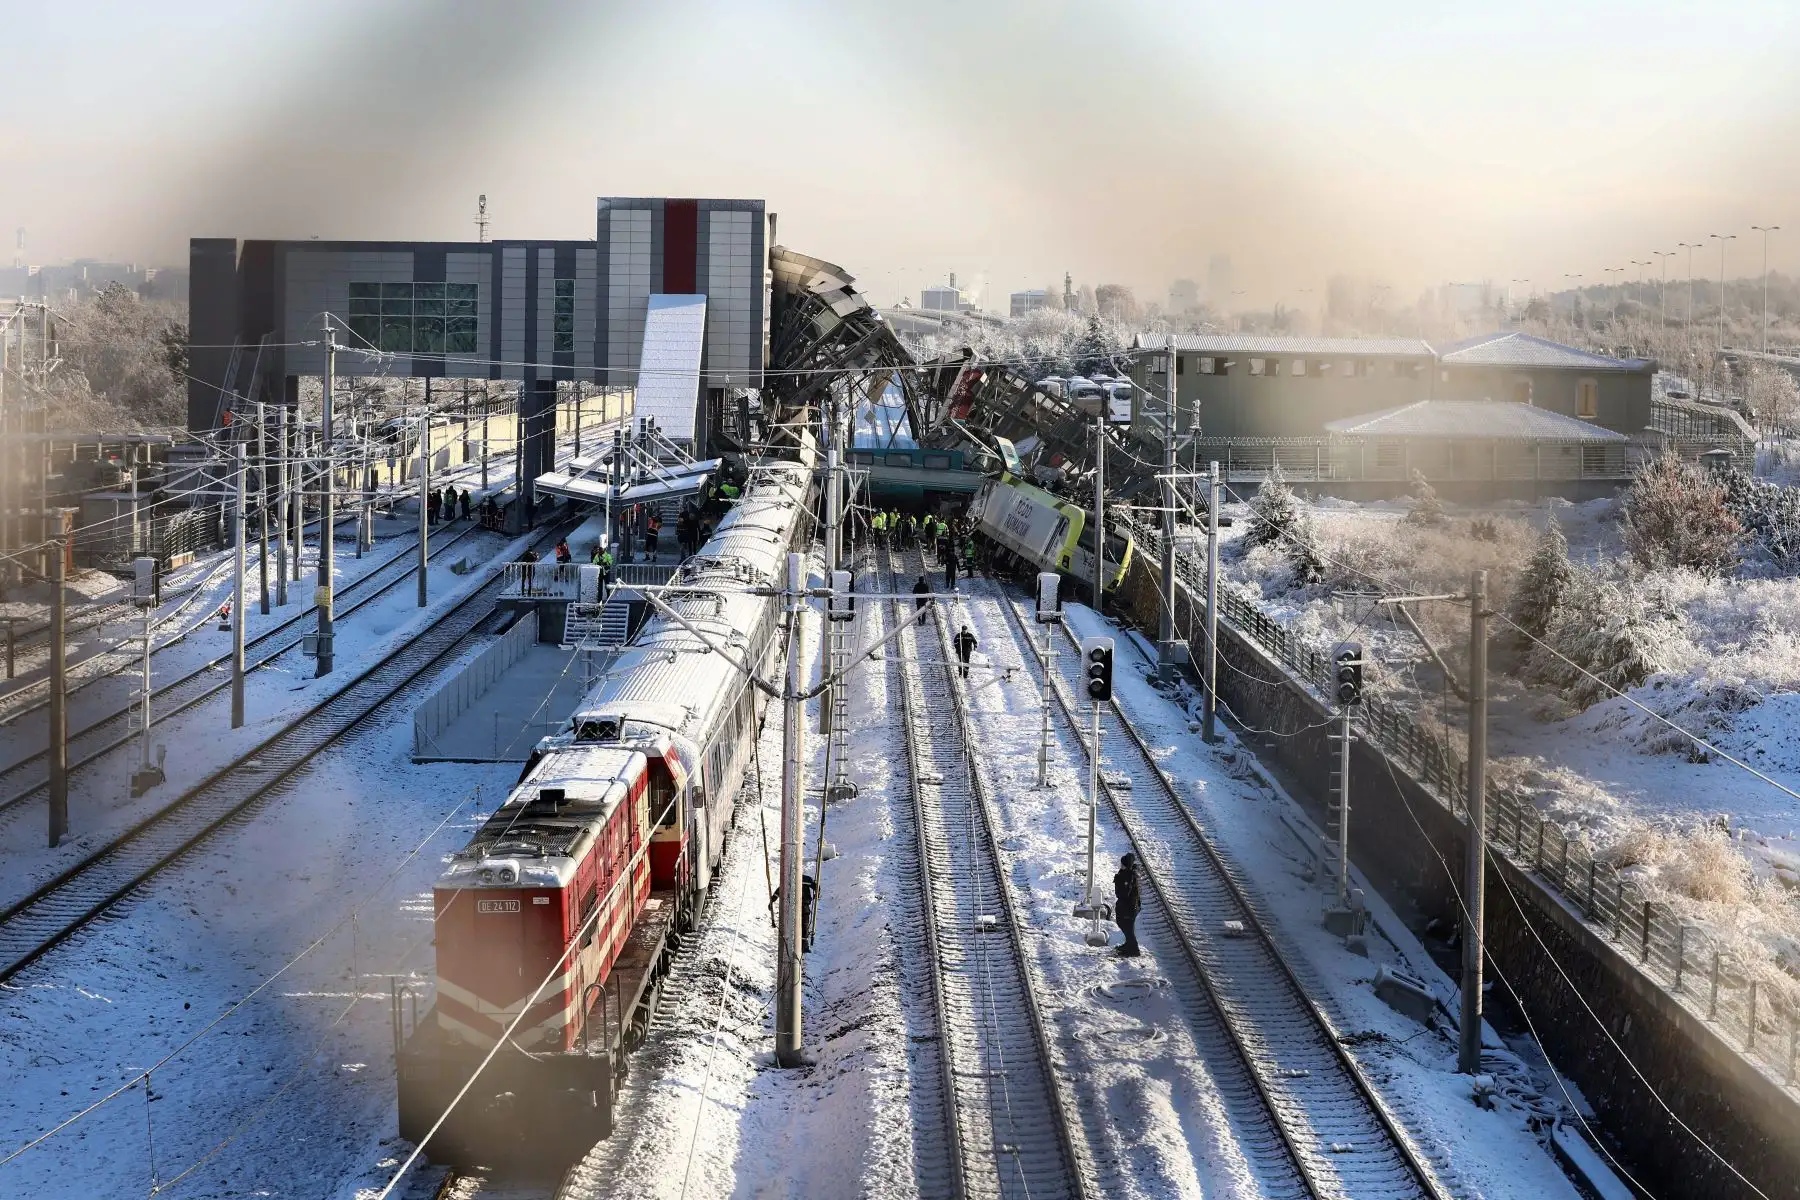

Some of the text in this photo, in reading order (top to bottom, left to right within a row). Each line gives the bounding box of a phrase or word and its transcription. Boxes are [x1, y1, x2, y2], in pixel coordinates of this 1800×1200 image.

[1015, 499, 1033, 519] TCDD
[482, 901, 517, 911] DE 24 112
